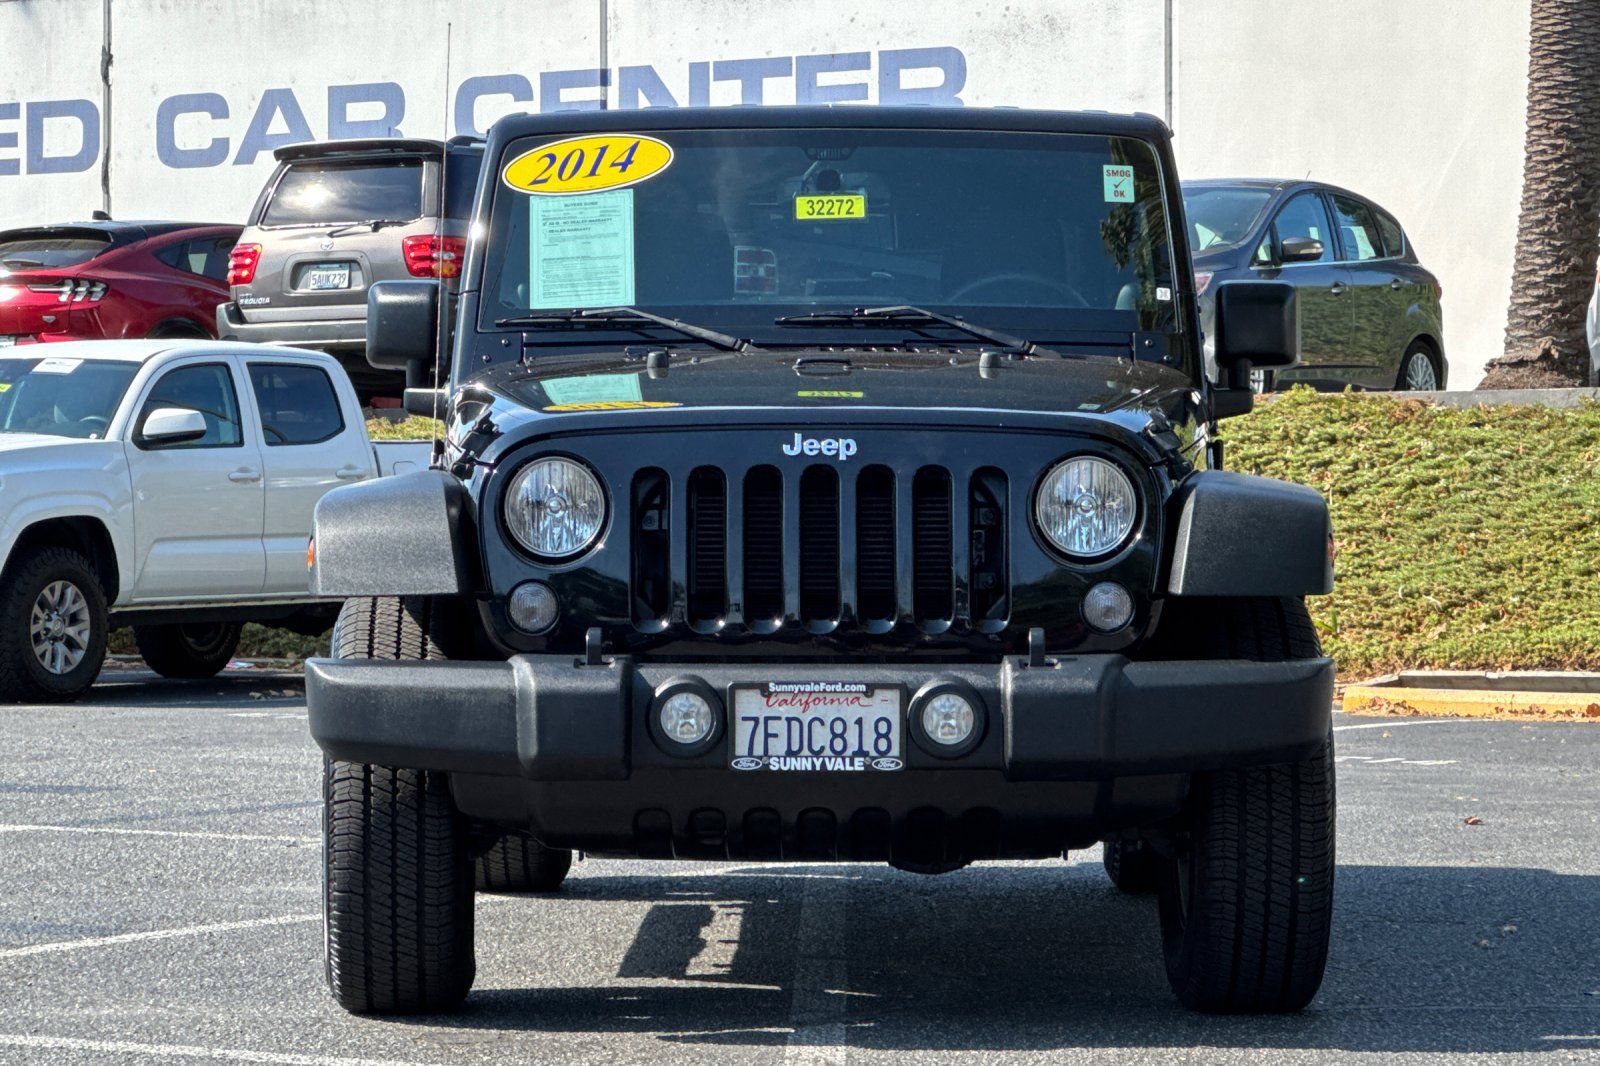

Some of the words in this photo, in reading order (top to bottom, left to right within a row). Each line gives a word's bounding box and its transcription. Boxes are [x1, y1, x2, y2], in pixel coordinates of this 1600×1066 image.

[156, 82, 406, 169] CAR
[528, 140, 641, 186] 2014
[1106, 169, 1131, 178] SMOG
[1113, 190, 1126, 198] OK
[806, 199, 855, 216] 32272
[783, 432, 857, 460] Jeep
[769, 682, 866, 693] SunnyvaleFord.com
[765, 691, 873, 713] California
[741, 716, 892, 756] 7FDC818
[737, 759, 757, 768] Ford
[769, 757, 865, 771] SUNNYVALE
[877, 759, 896, 769] Ford
